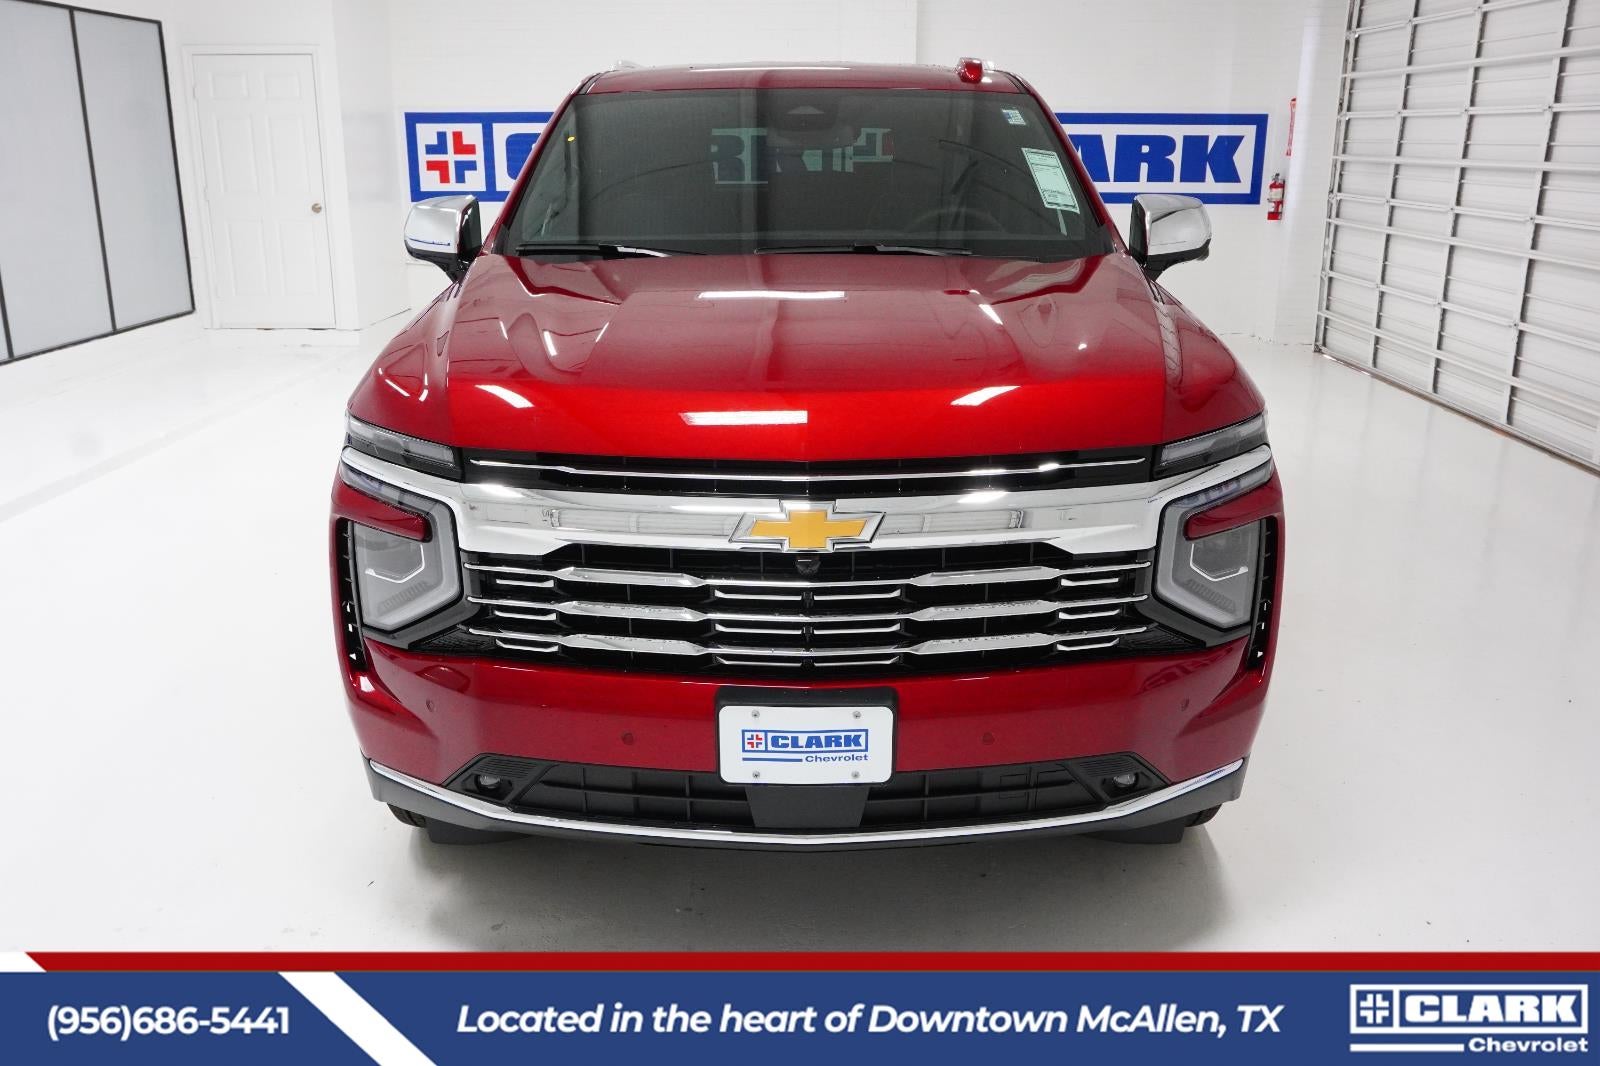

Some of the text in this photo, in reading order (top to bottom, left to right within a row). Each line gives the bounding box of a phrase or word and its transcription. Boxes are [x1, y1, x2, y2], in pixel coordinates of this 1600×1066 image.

[1068, 134, 1245, 184] ARK
[770, 734, 863, 749] CLARK
[805, 753, 869, 763] Chevrolet
